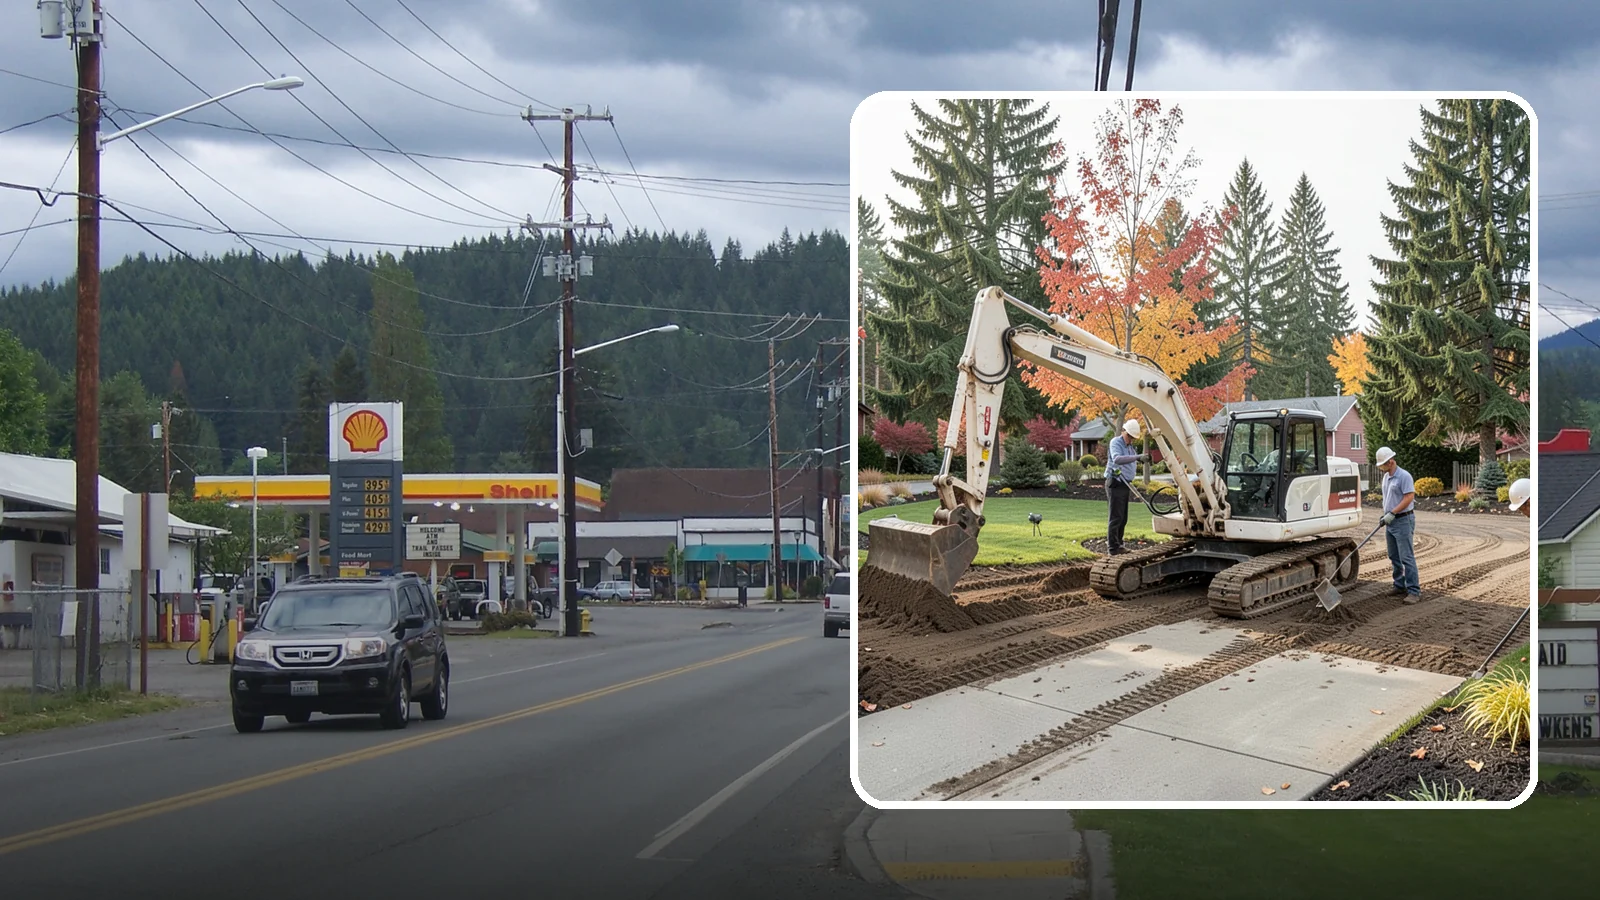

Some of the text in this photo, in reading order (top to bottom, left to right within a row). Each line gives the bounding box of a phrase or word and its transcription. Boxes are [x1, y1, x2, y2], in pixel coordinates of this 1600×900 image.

[366, 480, 383, 490] 395
[490, 484, 547, 499] Shell
[366, 494, 383, 504] 405
[366, 508, 383, 518] 415
[366, 522, 383, 533] 429
[1538, 643, 1567, 665] AID
